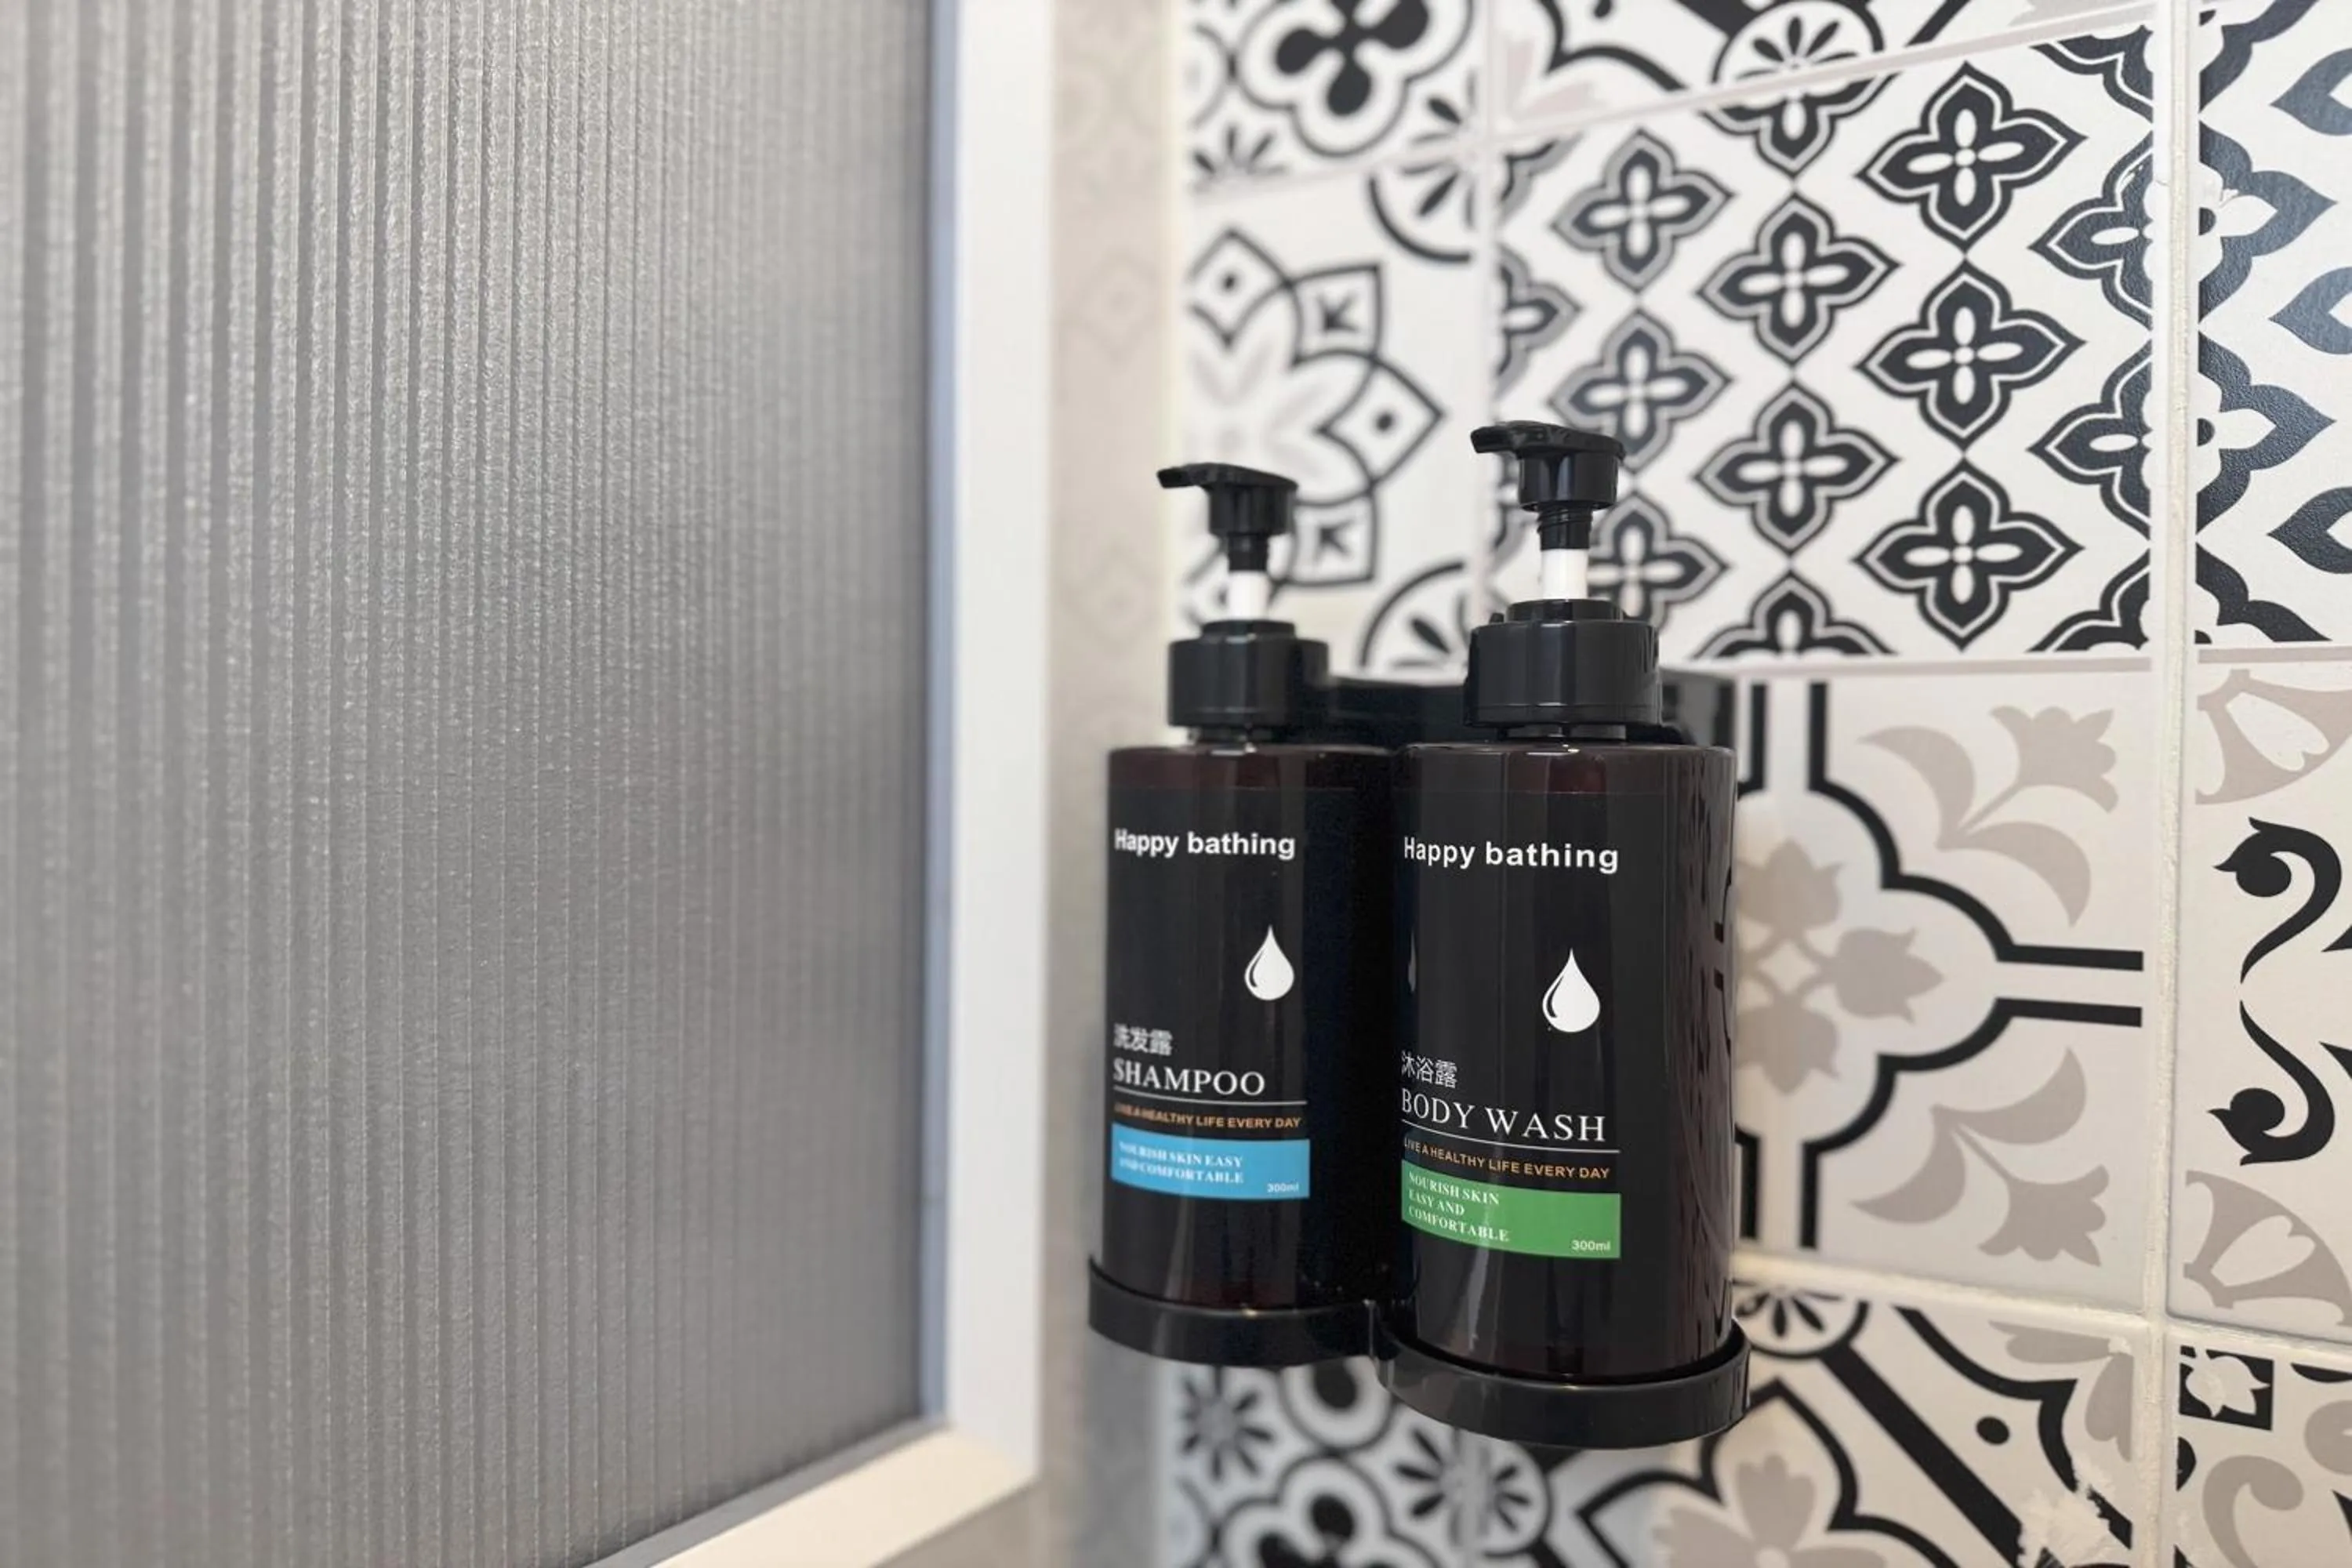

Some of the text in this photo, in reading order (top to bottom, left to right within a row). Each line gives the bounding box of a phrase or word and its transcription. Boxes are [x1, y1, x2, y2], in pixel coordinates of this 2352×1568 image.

[1114, 828, 1295, 860] Happy bathing
[1404, 836, 1618, 874] Happy bathing
[1113, 1058, 1265, 1095] SHAMPOO
[1402, 1050, 1457, 1088] 沐浴露
[1142, 1108, 1194, 1125] HEALTHY
[1196, 1115, 1225, 1128] LIFE
[1227, 1117, 1272, 1128] EVERY
[1275, 1117, 1301, 1128] DAY
[1402, 1087, 1606, 1142] BODY WASH
[1139, 1163, 1244, 1184] COMFORTABLE
[1169, 1151, 1202, 1166] SKIN
[1205, 1155, 1243, 1167] EASY
[1430, 1147, 1486, 1167] HEALTHY
[1489, 1160, 1520, 1174] LIFE
[1524, 1163, 1575, 1178] EVERY
[1579, 1167, 1610, 1178] DAY
[1267, 1182, 1299, 1192] 300ml
[1409, 1171, 1500, 1205] NOURISH SKIN
[1409, 1189, 1465, 1216] EASY AND
[1409, 1205, 1510, 1242] COMFORTABLE
[1572, 1240, 1610, 1251] 300ml
